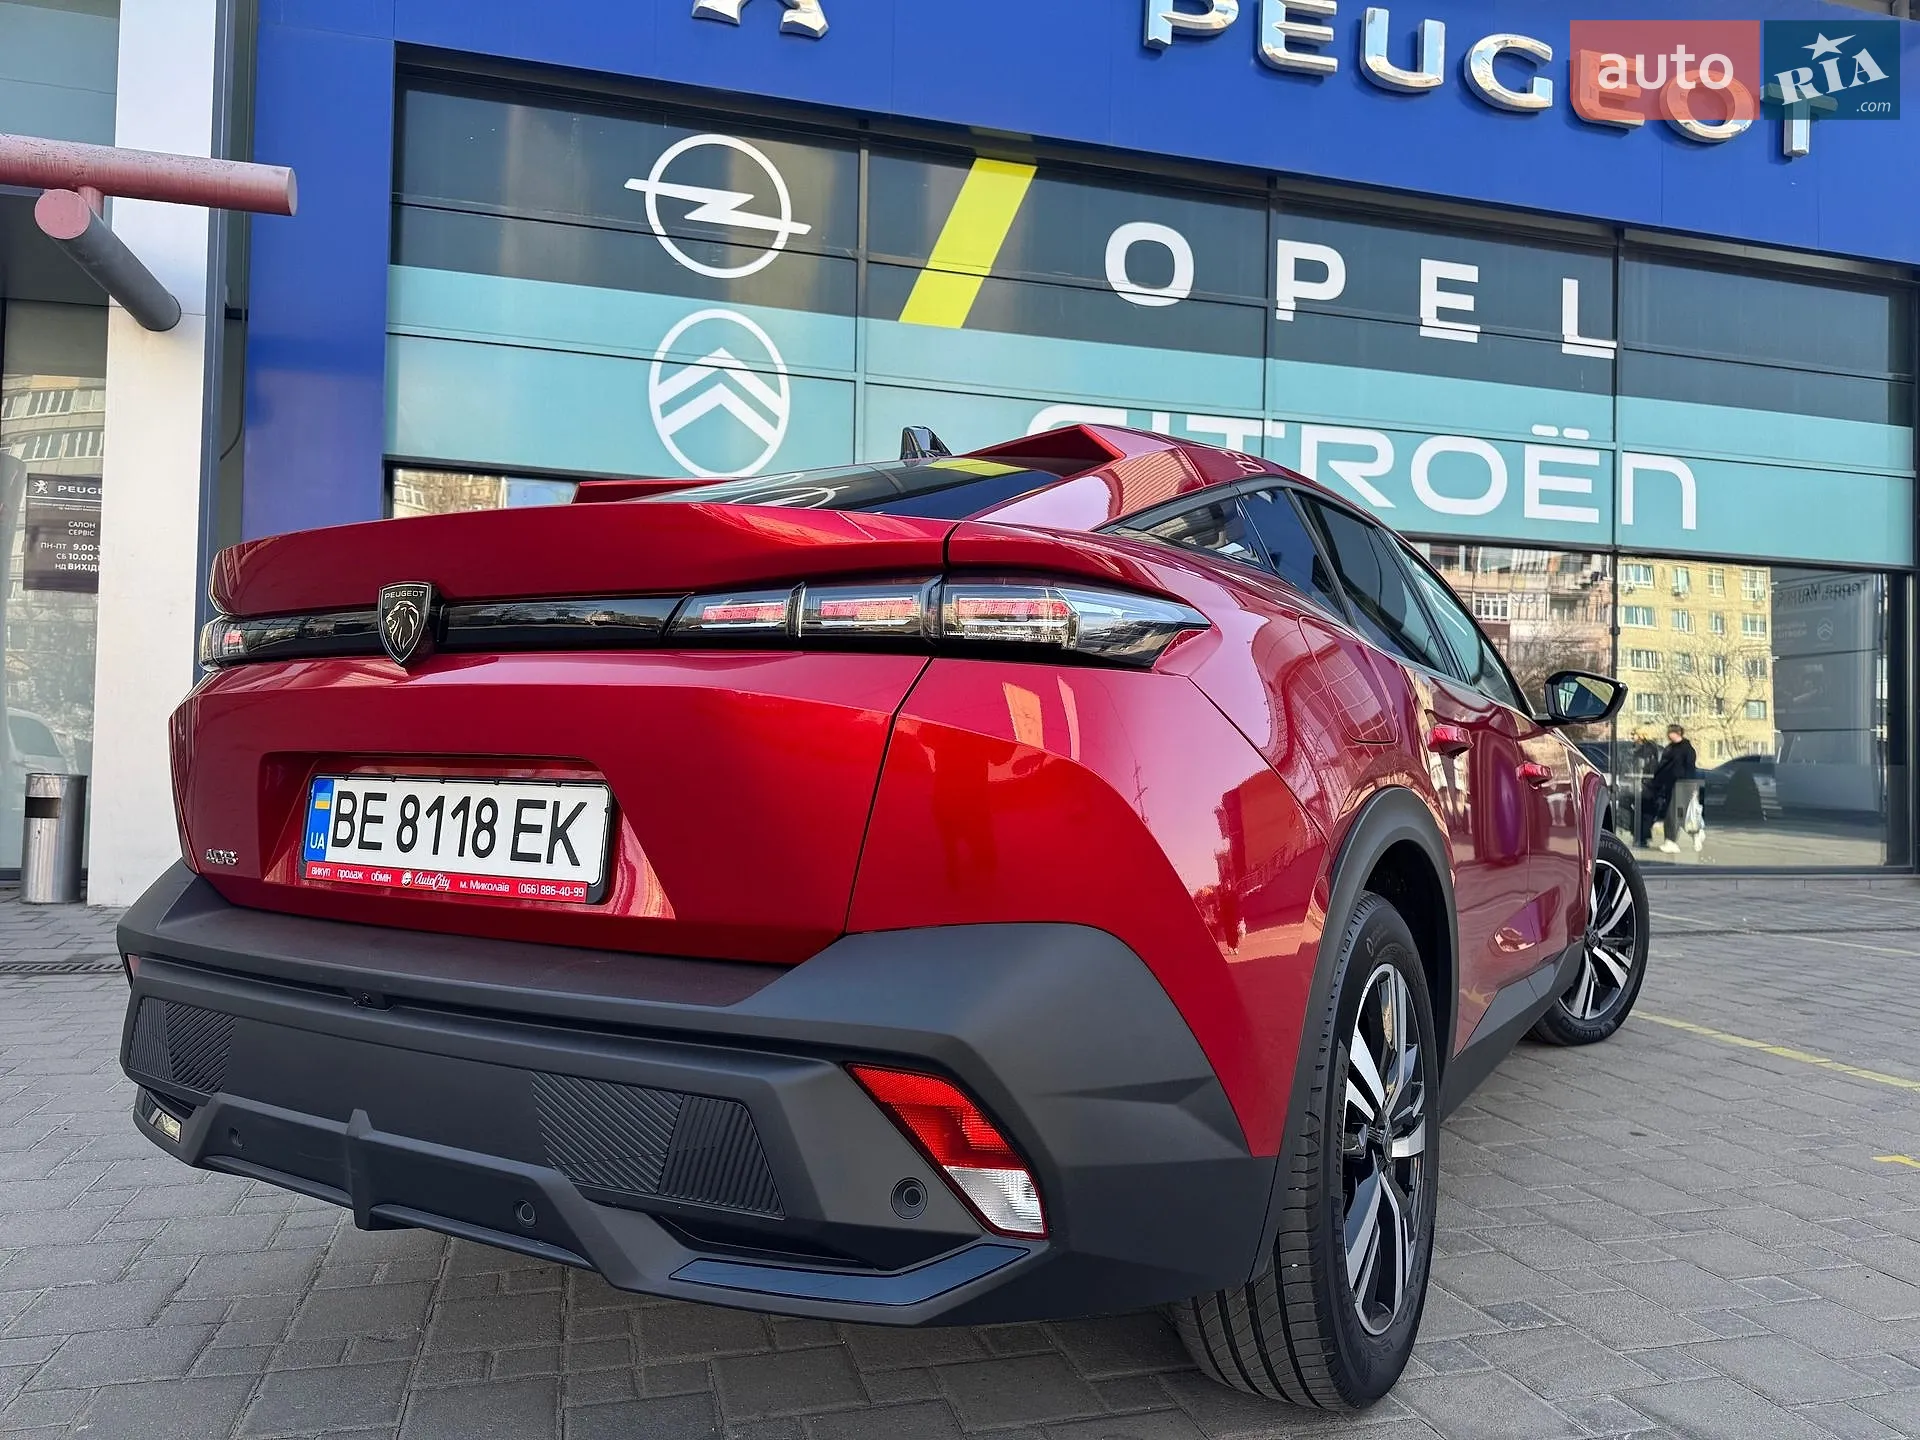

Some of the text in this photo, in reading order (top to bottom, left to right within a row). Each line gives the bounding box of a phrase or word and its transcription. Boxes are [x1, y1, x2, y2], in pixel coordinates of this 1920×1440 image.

[1144, 0, 1838, 157] PEUGEOT
[1105, 221, 1618, 360] OPEL
[68, 521, 96, 529] САЛОН
[68, 529, 95, 537] СЕРВІС
[384, 590, 425, 600] PEUGEOT
[310, 831, 326, 849] UA
[331, 790, 588, 866] BE 8118 EK
[311, 866, 331, 878] викуп
[337, 869, 364, 881] продаж
[370, 871, 392, 883] обмін
[414, 871, 451, 890] AutoCity
[469, 879, 510, 892] Миколаїв
[518, 883, 540, 895] (066)
[540, 885, 585, 898] 886-40-99
